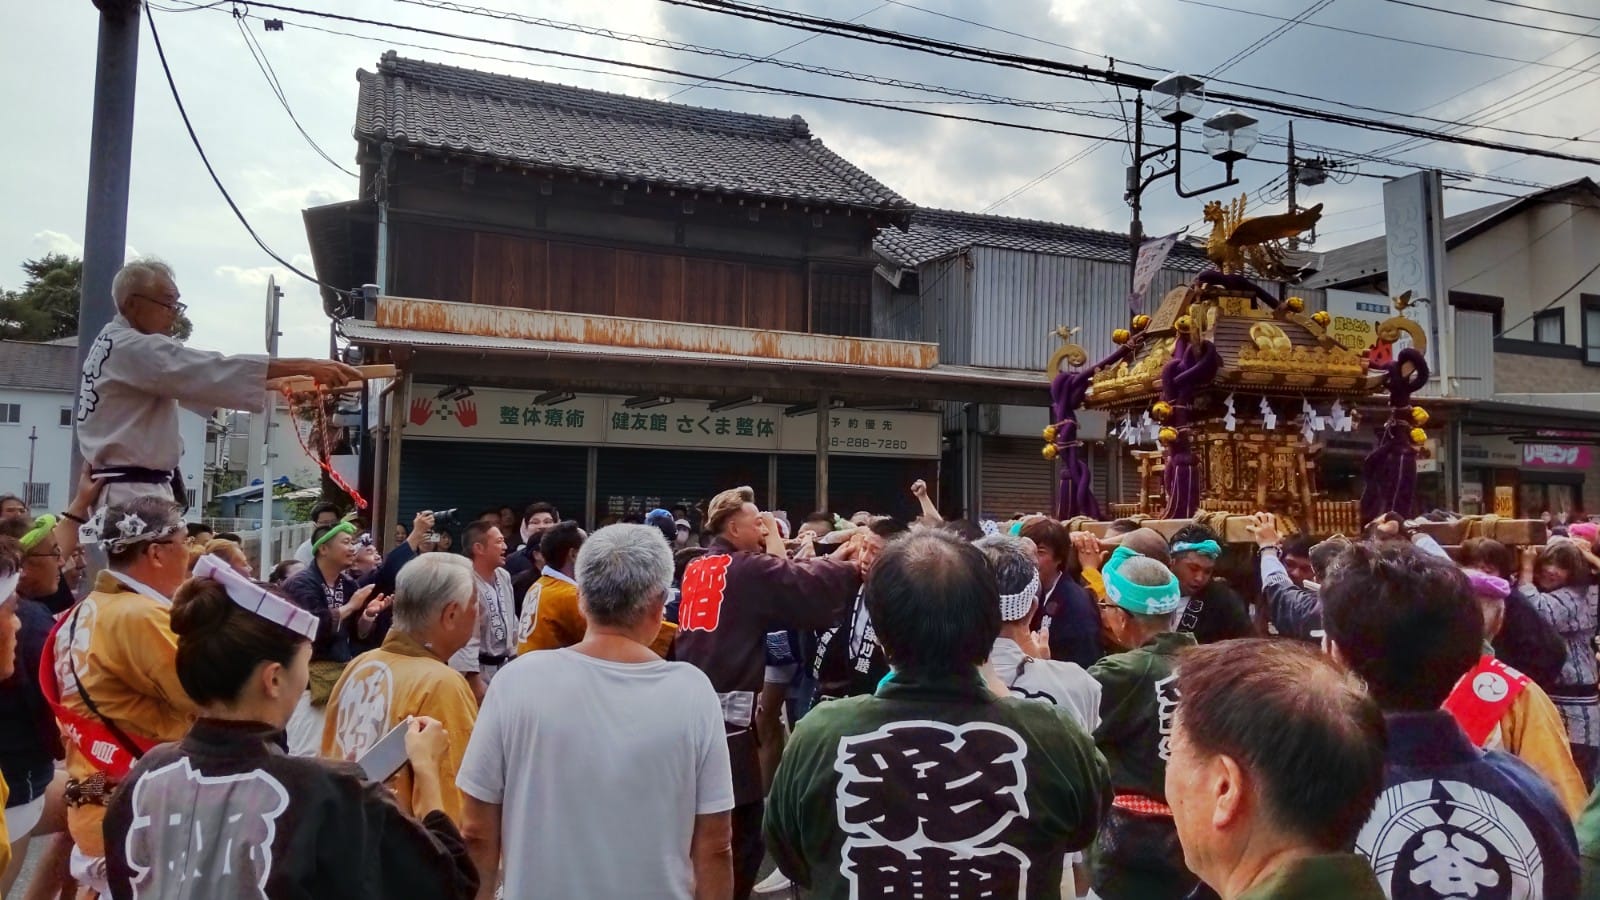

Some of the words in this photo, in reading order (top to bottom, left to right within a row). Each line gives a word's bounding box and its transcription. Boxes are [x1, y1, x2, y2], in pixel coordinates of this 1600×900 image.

[499, 406, 585, 428] 整体療術
[611, 411, 668, 432] 健友館
[676, 415, 775, 438] さくま整体
[831, 417, 893, 431] 予約優先
